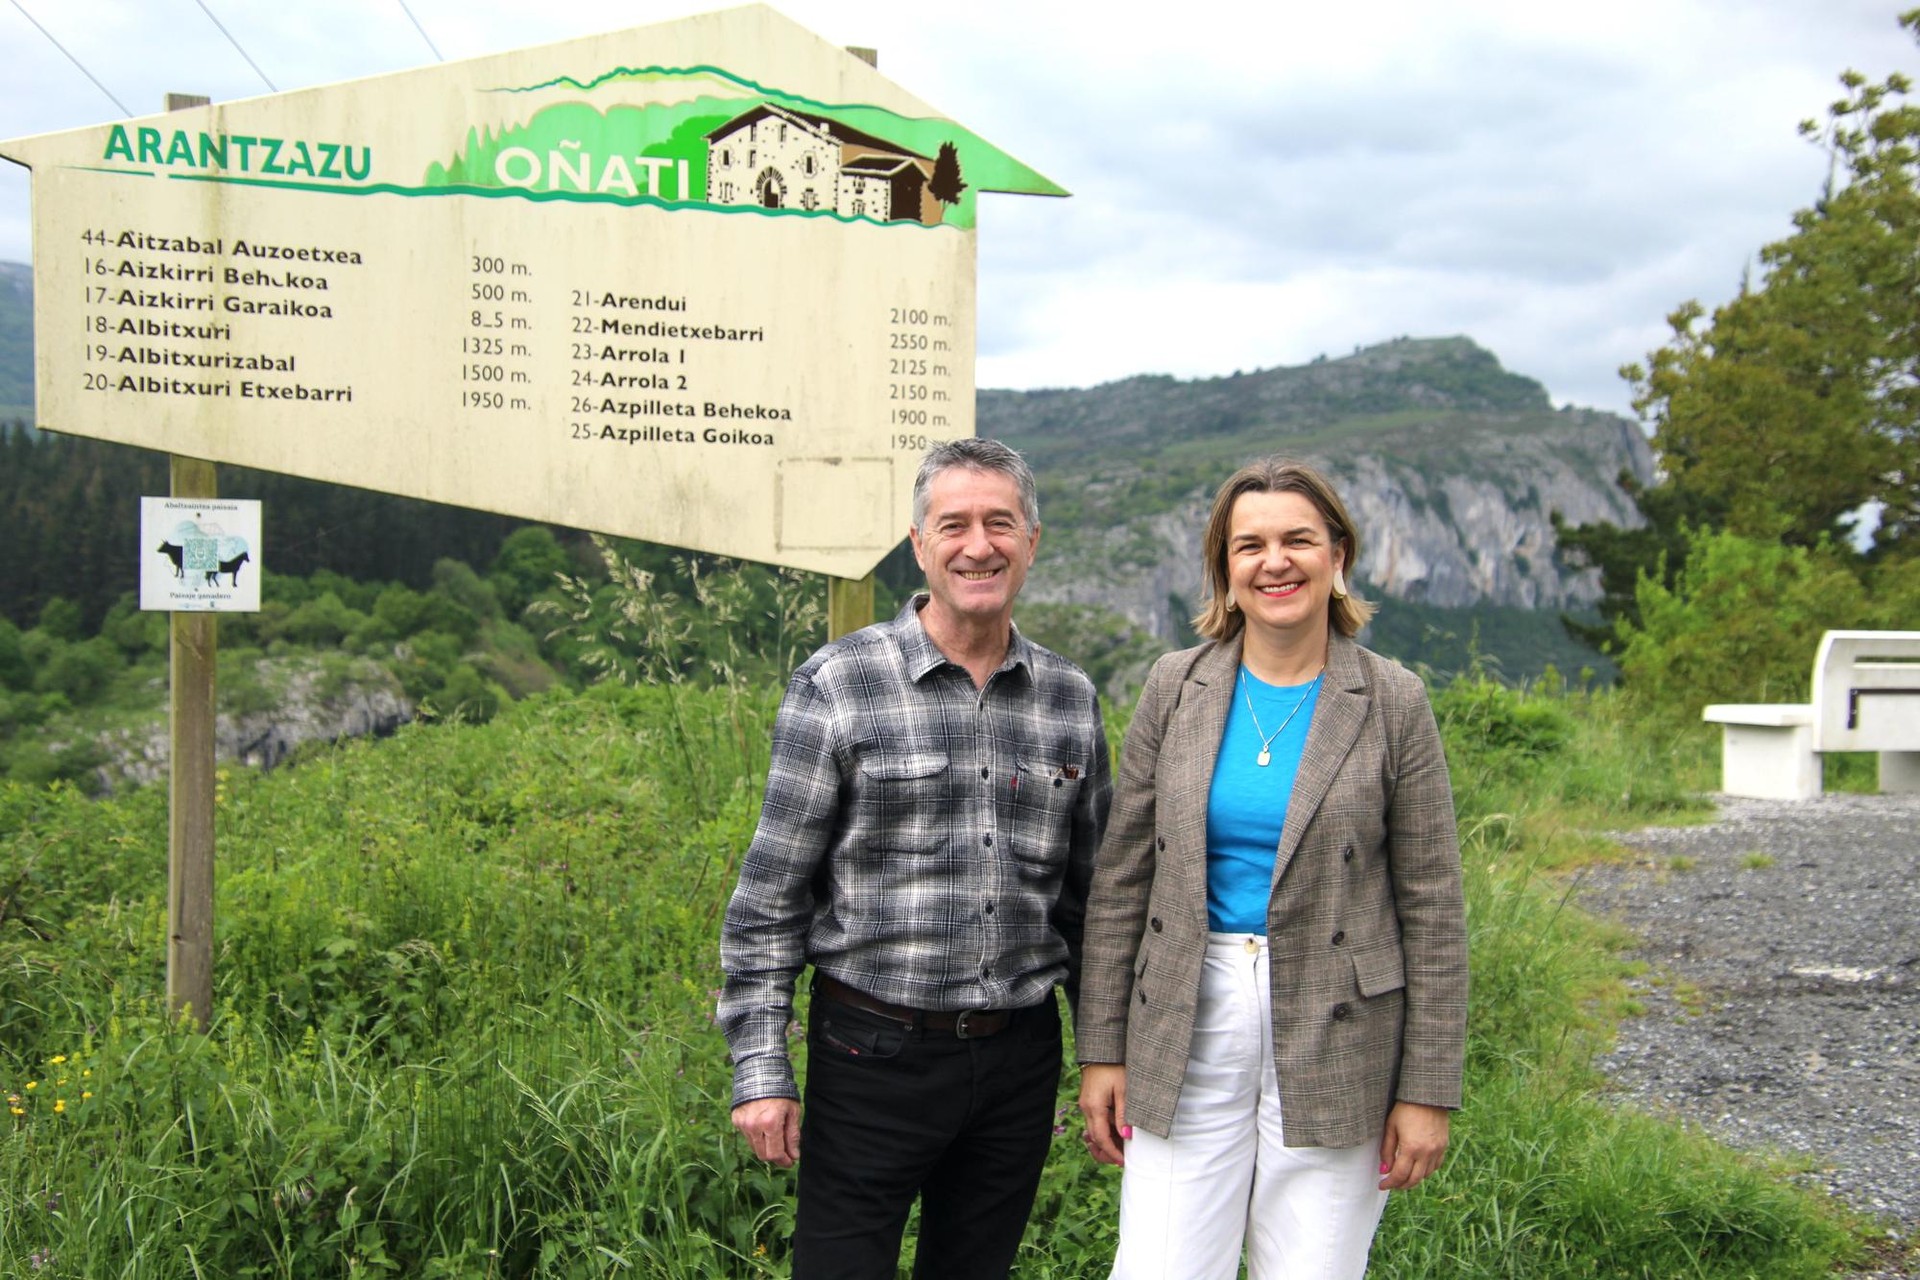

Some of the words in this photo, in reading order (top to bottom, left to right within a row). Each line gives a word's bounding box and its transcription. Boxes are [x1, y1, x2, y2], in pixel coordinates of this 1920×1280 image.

[104, 124, 371, 180] ARANTZAZU
[495, 140, 689, 201] OÑATI
[232, 240, 362, 265] Auzoetxea
[472, 256, 504, 273] 300
[472, 283, 504, 301] 500
[223, 296, 332, 318] Garaikoa
[471, 311, 503, 328] 85
[891, 308, 928, 324] 2100
[464, 337, 503, 355] 1325
[891, 333, 927, 349] 2550
[463, 364, 503, 381] 1500
[891, 359, 926, 375] 2125
[241, 381, 352, 402] Etxebarri
[676, 375, 688, 391] 2
[463, 392, 503, 409] 1950
[890, 384, 927, 400] 2150
[704, 402, 791, 421] Behekoa
[892, 410, 926, 425] 1900
[703, 428, 774, 445] Goikoa
